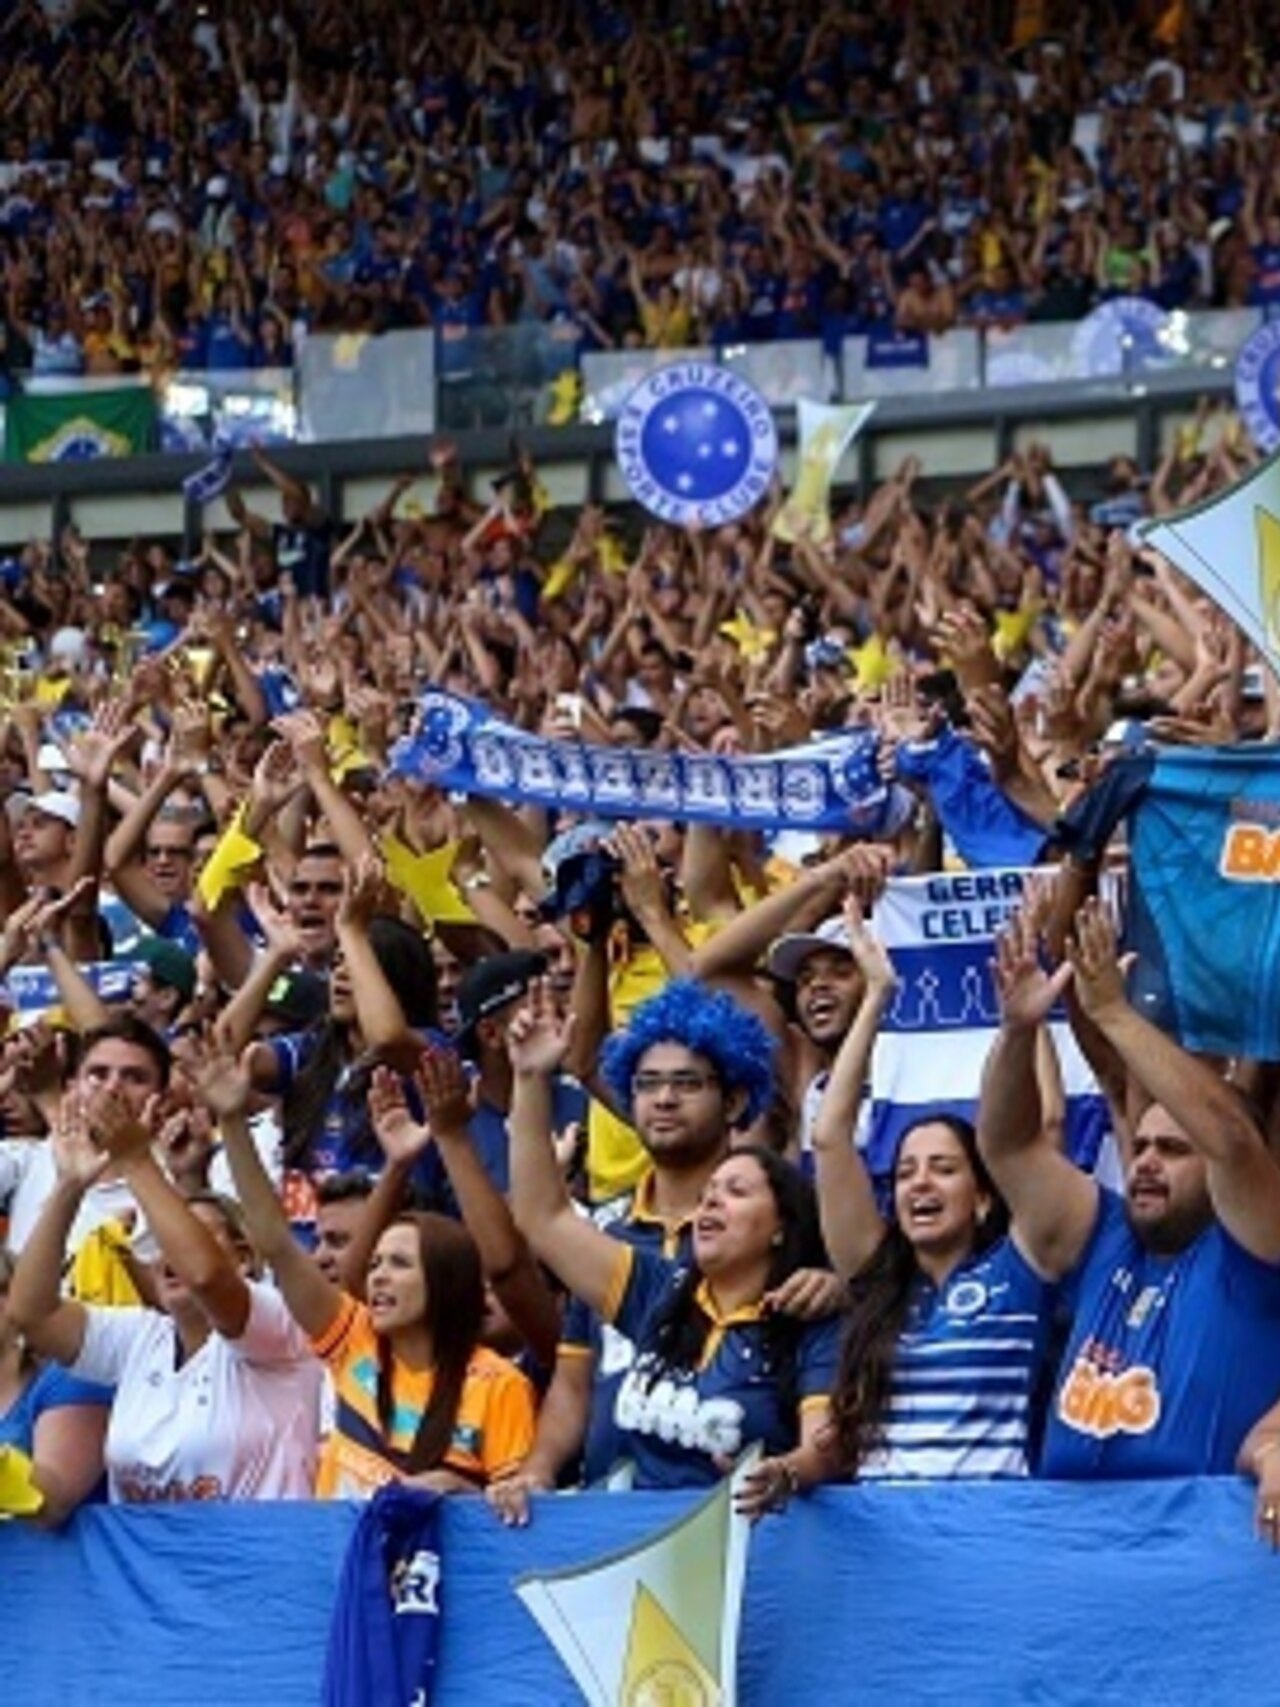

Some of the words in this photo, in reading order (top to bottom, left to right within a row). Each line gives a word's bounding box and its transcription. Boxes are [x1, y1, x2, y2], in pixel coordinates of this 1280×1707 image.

[650, 365, 770, 440] CRUZEIRO
[470, 732, 828, 823] CRUZEIRO
[926, 872, 1034, 903] GERA
